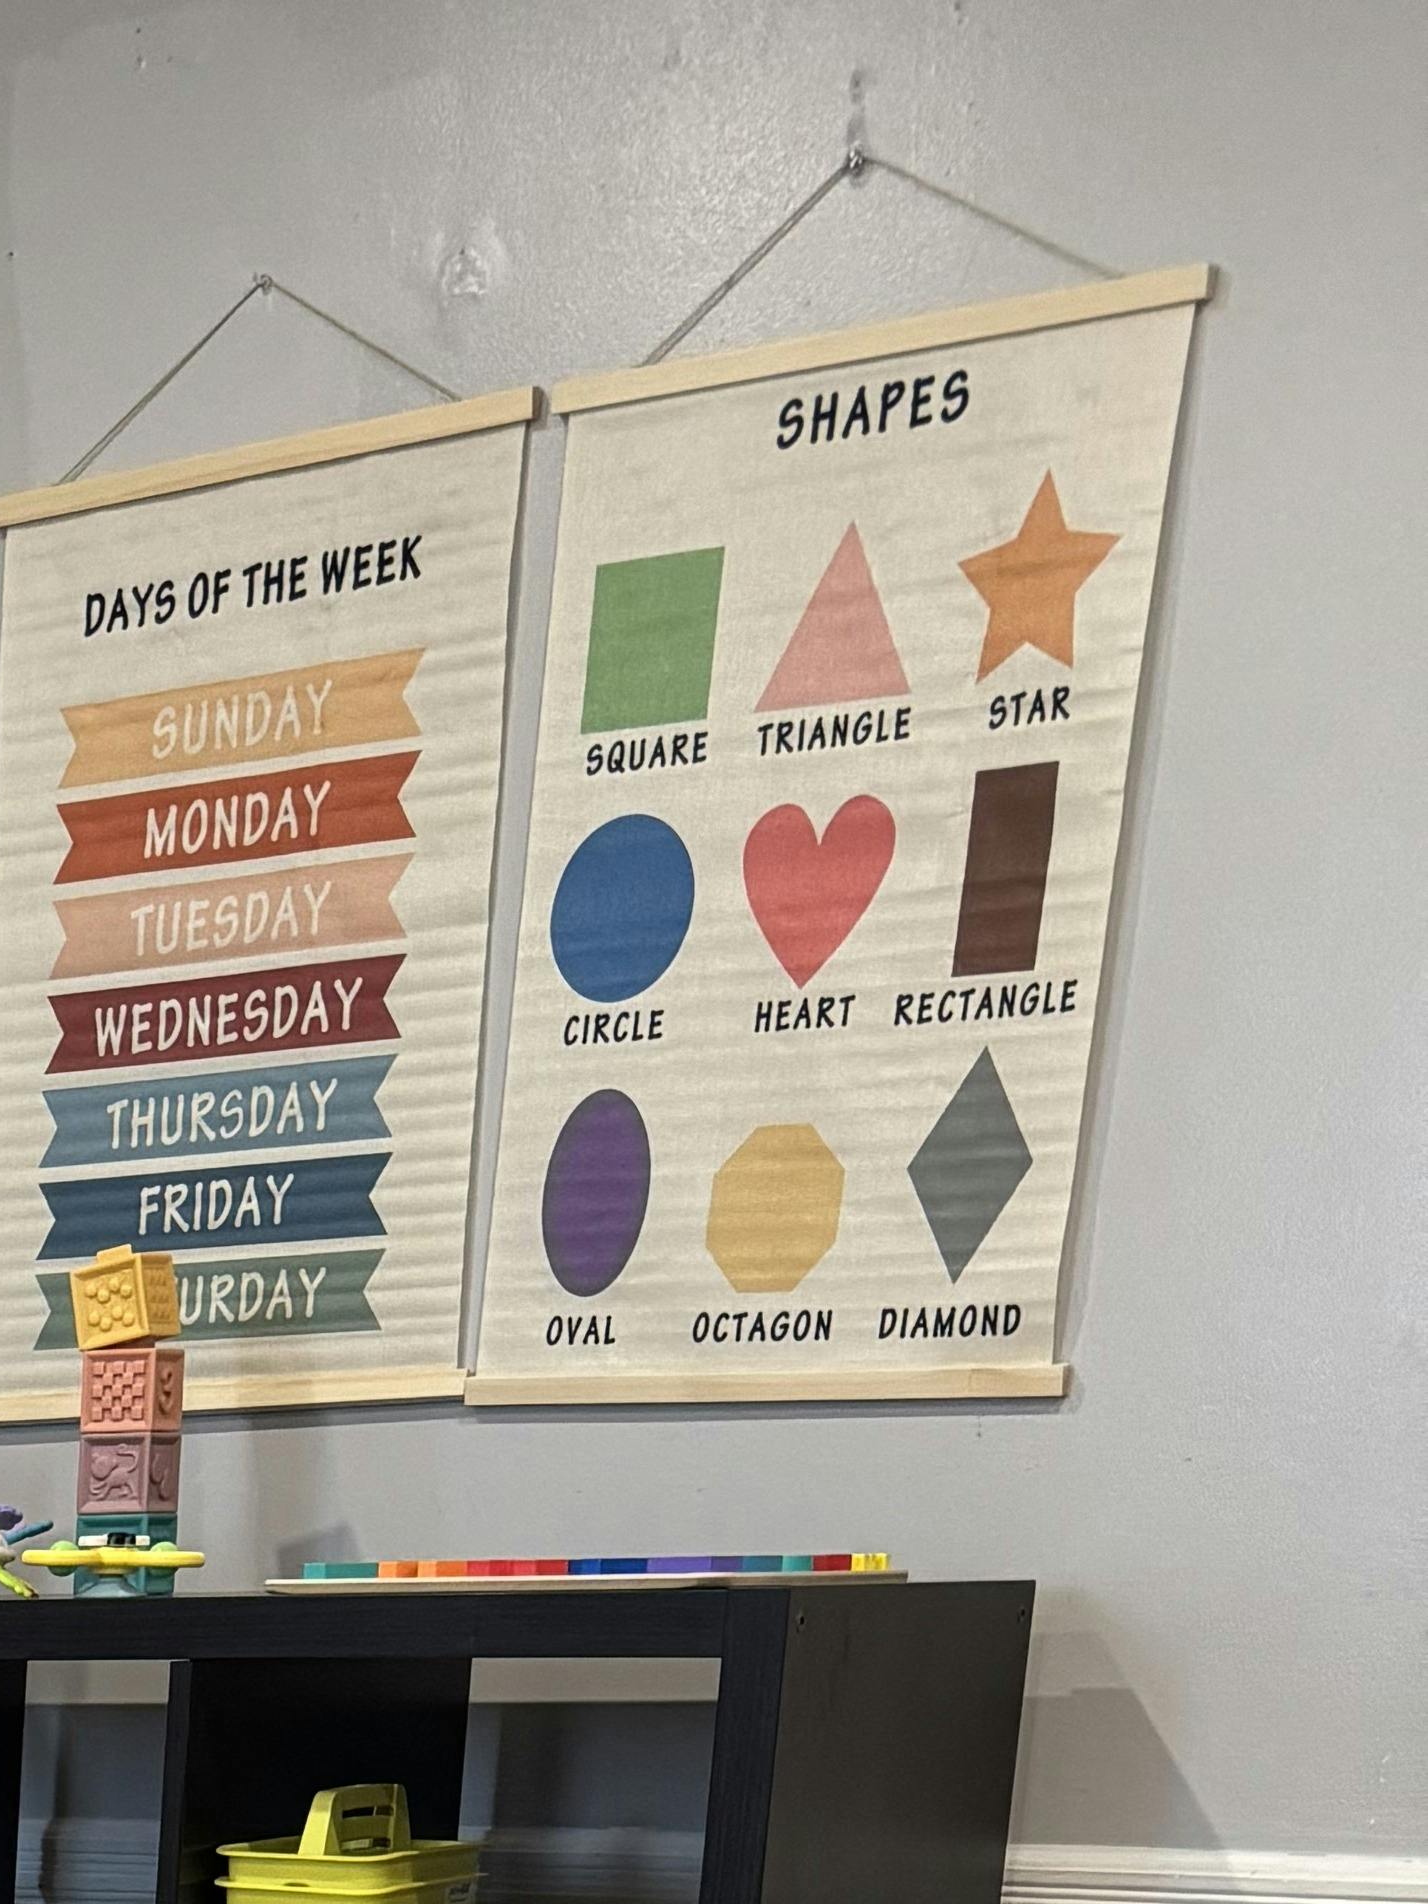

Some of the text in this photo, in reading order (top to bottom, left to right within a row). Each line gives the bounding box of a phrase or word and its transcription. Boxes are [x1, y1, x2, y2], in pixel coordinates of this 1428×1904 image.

[776, 368, 970, 450] SHAPES
[85, 535, 422, 637] DAYS OF THE WEEK
[150, 679, 333, 761] SUNDAY
[587, 686, 1070, 776] SQUARE TRIANGLE STAR
[142, 781, 333, 860] MONDAY
[129, 880, 333, 958] TUESDAY
[93, 977, 365, 1058] WEDNESDAY
[564, 979, 1078, 1046] CIRCLE HEART RECTANGLE
[106, 1078, 338, 1151] THURSDAY
[138, 1173, 294, 1236] FRIDAY
[178, 1266, 327, 1325] URDAY
[546, 1304, 1021, 1346] OVAL OCTAGON DIAMOND
